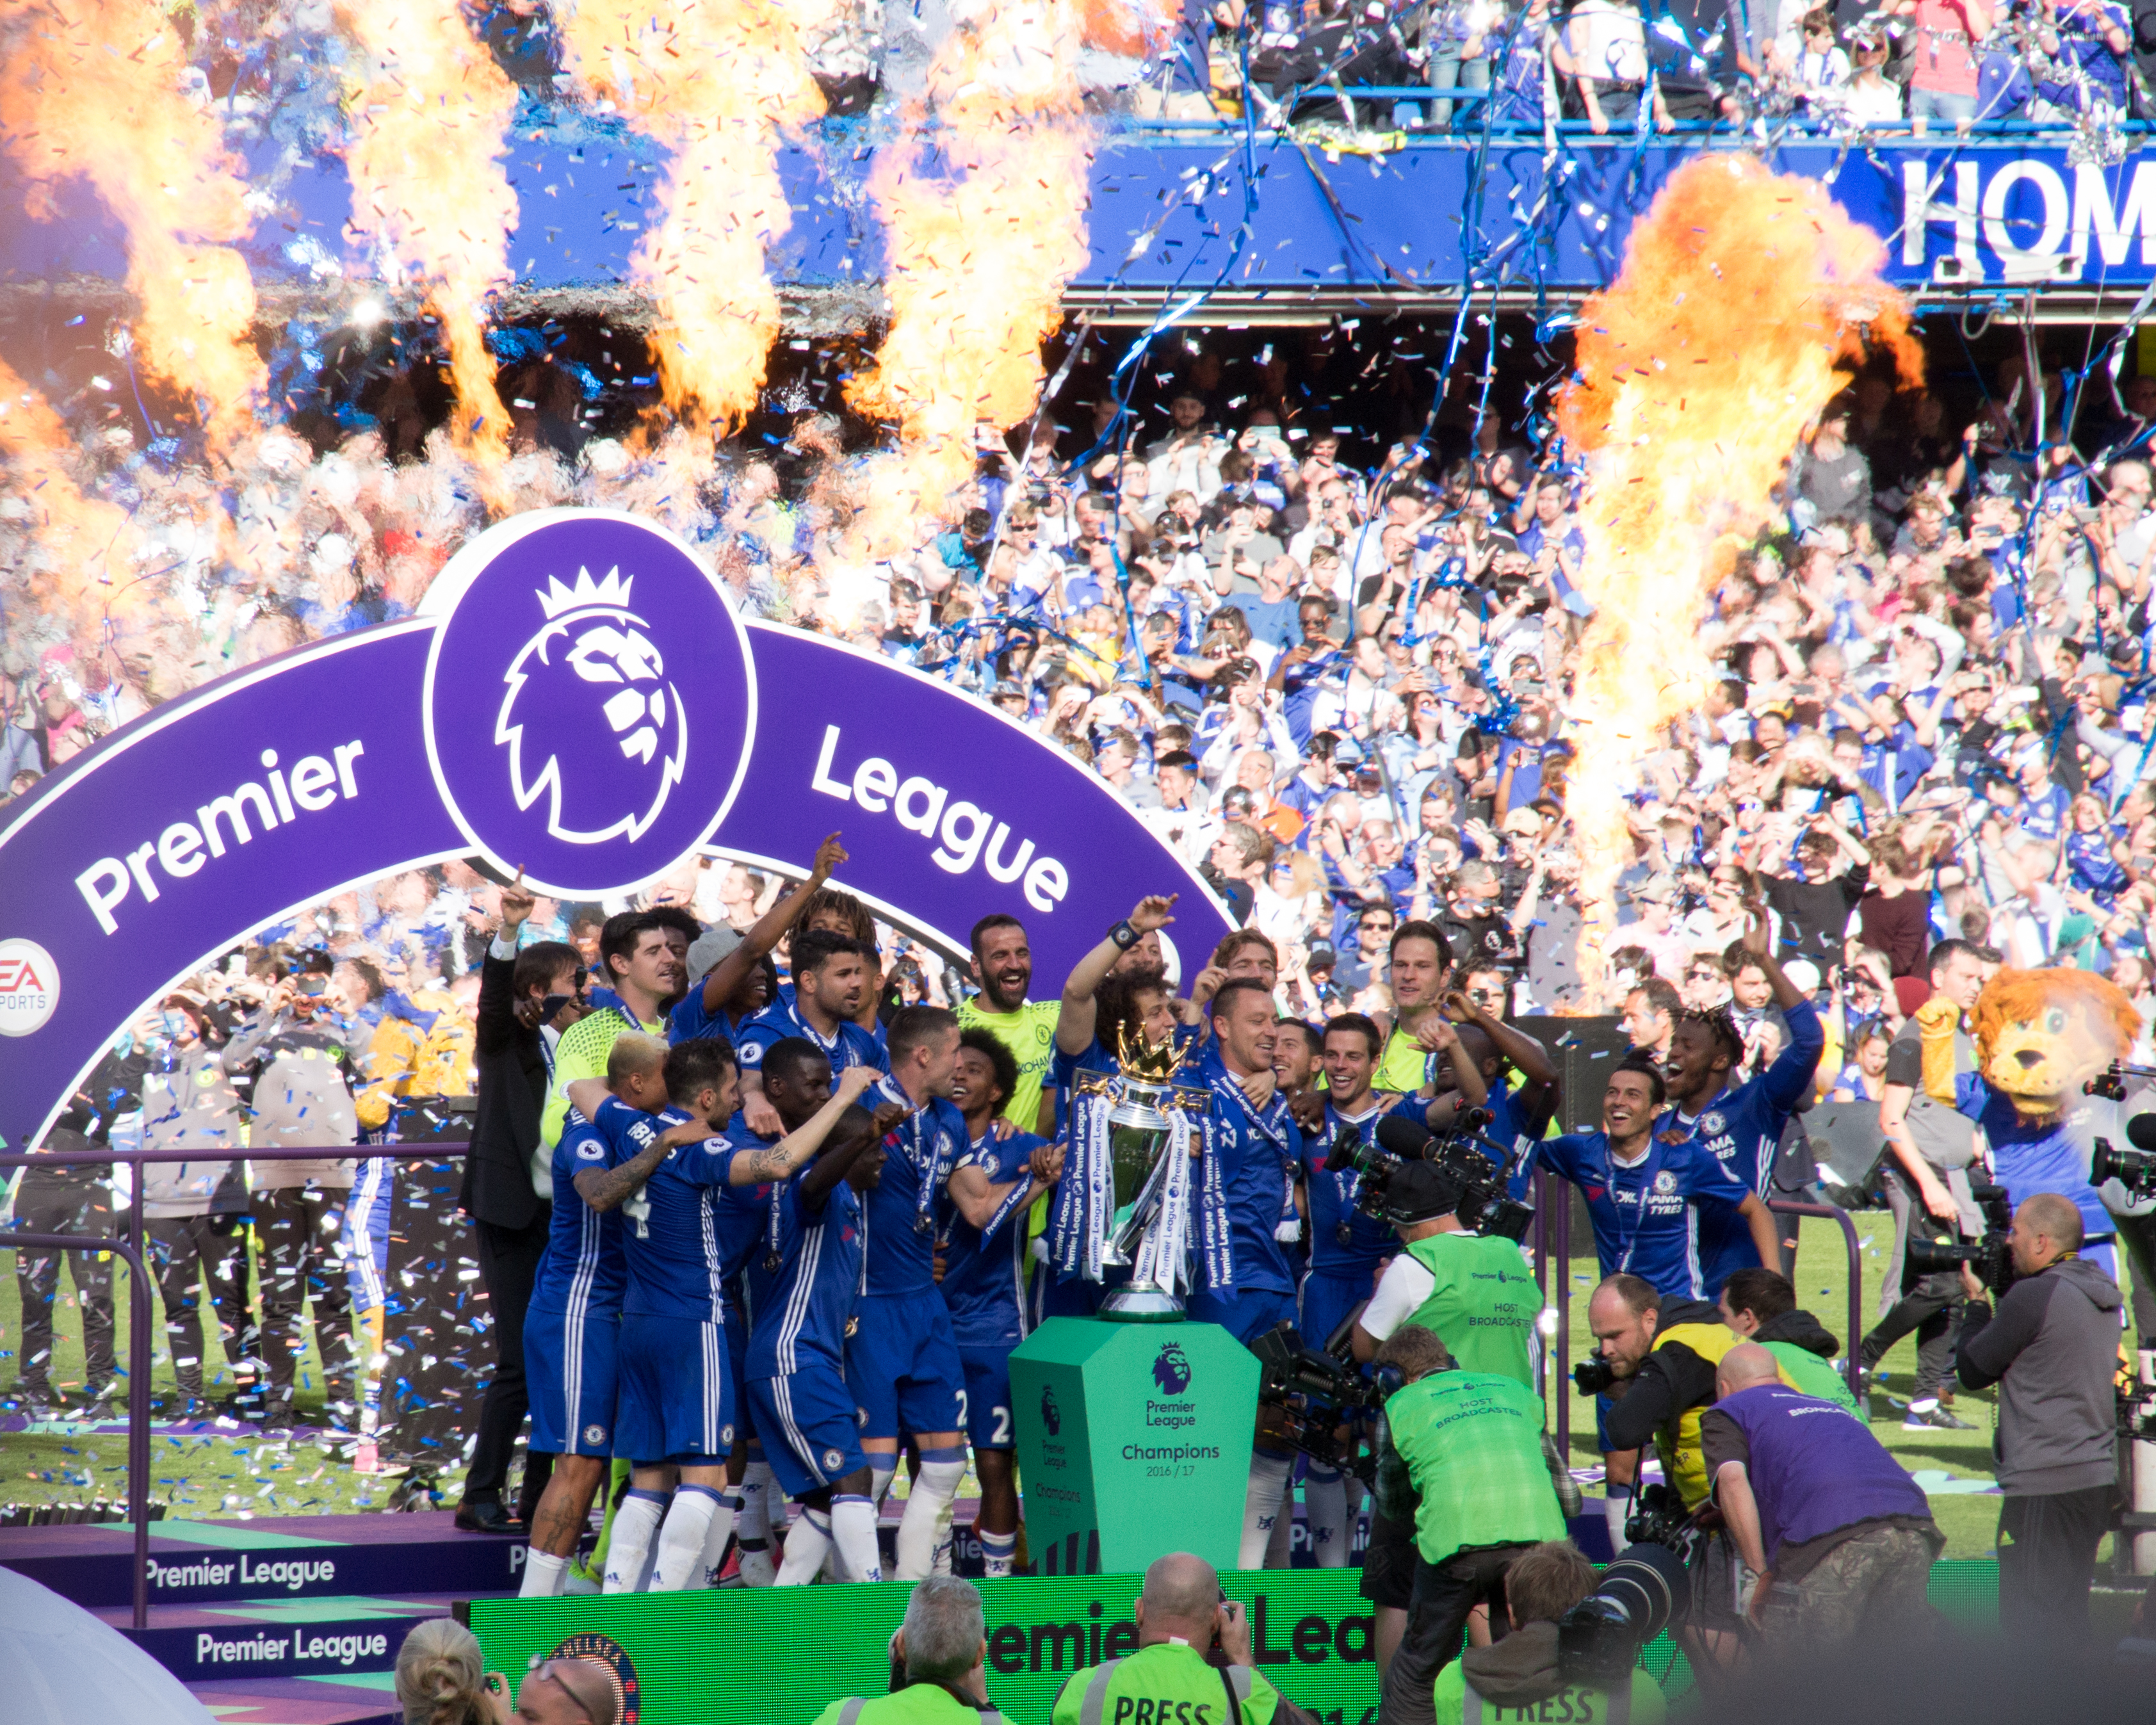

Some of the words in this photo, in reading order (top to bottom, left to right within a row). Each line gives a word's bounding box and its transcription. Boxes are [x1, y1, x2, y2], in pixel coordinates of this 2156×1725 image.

[74, 740, 364, 936] Premier
[811, 724, 1069, 912] League
[1220, 1076, 1239, 1097] Premier
[1236, 1094, 1255, 1117] League
[1074, 1101, 1087, 1140] League
[1093, 1103, 1106, 1138] League
[1174, 1112, 1187, 1144] League
[1201, 1117, 1215, 1153] League
[1073, 1142, 1085, 1179] Premier
[1093, 1141, 1101, 1178] Premier
[1171, 1147, 1184, 1183] Premier
[1716, 1147, 1737, 1160] RES
[1203, 1155, 1213, 1192] Premier
[986, 1203, 1009, 1236] Premier
[1007, 1173, 1030, 1205] Leagu
[1070, 1197, 1083, 1235] League
[1092, 1196, 1103, 1234] League
[1163, 1201, 1177, 1238] League
[1650, 1204, 1683, 1215] TYRES
[1053, 1229, 1066, 1261] Premier
[1144, 1216, 1160, 1244] Leag
[1205, 1211, 1216, 1249] League
[1218, 1208, 1230, 1246] League
[1064, 1236, 1080, 1272] Premier
[1160, 1240, 1172, 1277] Premier
[1207, 1251, 1219, 1288] Premier
[1220, 1247, 1233, 1285] Premier
[1495, 1303, 1518, 1313] HOST
[1146, 1400, 1196, 1413] Premier
[1436, 1407, 1523, 1429] BROADCASTER
[1459, 1397, 1493, 1409] HOST
[1146, 1414, 1196, 1430] League
[1122, 1443, 1220, 1462] Champions
[1146, 1466, 1172, 1477] 2016
[240, 1554, 336, 1590] League
[197, 1632, 289, 1664] Premier
[295, 1629, 387, 1665] League
[1114, 1696, 1212, 1725] PRESS
